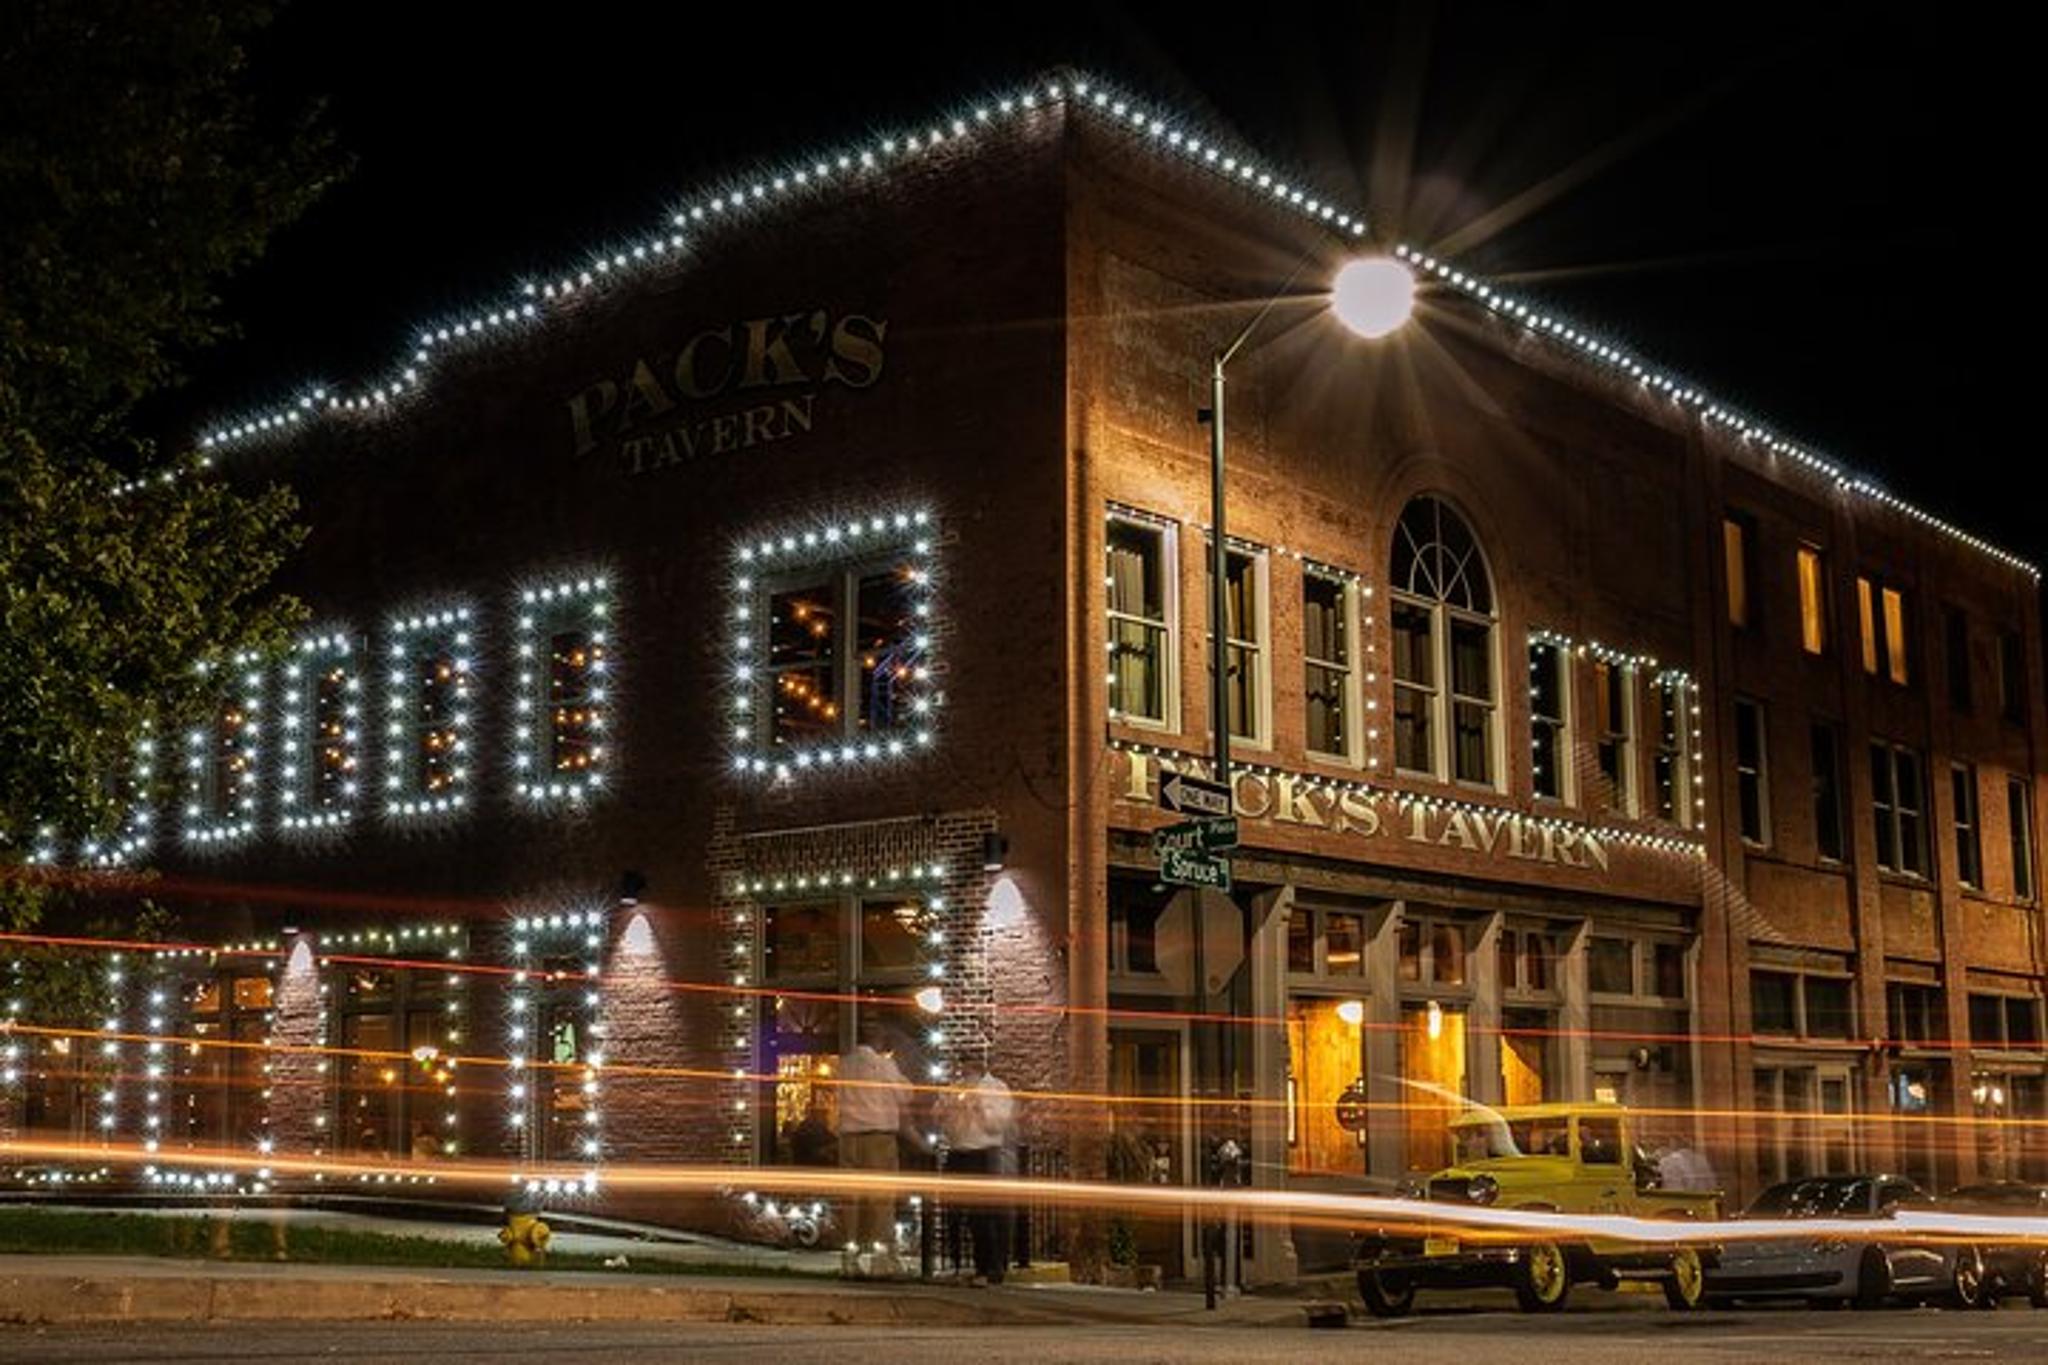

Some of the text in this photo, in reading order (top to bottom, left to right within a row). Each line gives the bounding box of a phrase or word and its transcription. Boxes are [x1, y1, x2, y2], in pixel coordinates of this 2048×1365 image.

[567, 310, 888, 457] PACK'S
[623, 394, 815, 474] TAVERN
[1172, 853, 1218, 884] Spruce
[1402, 797, 1608, 873] TAVERN
